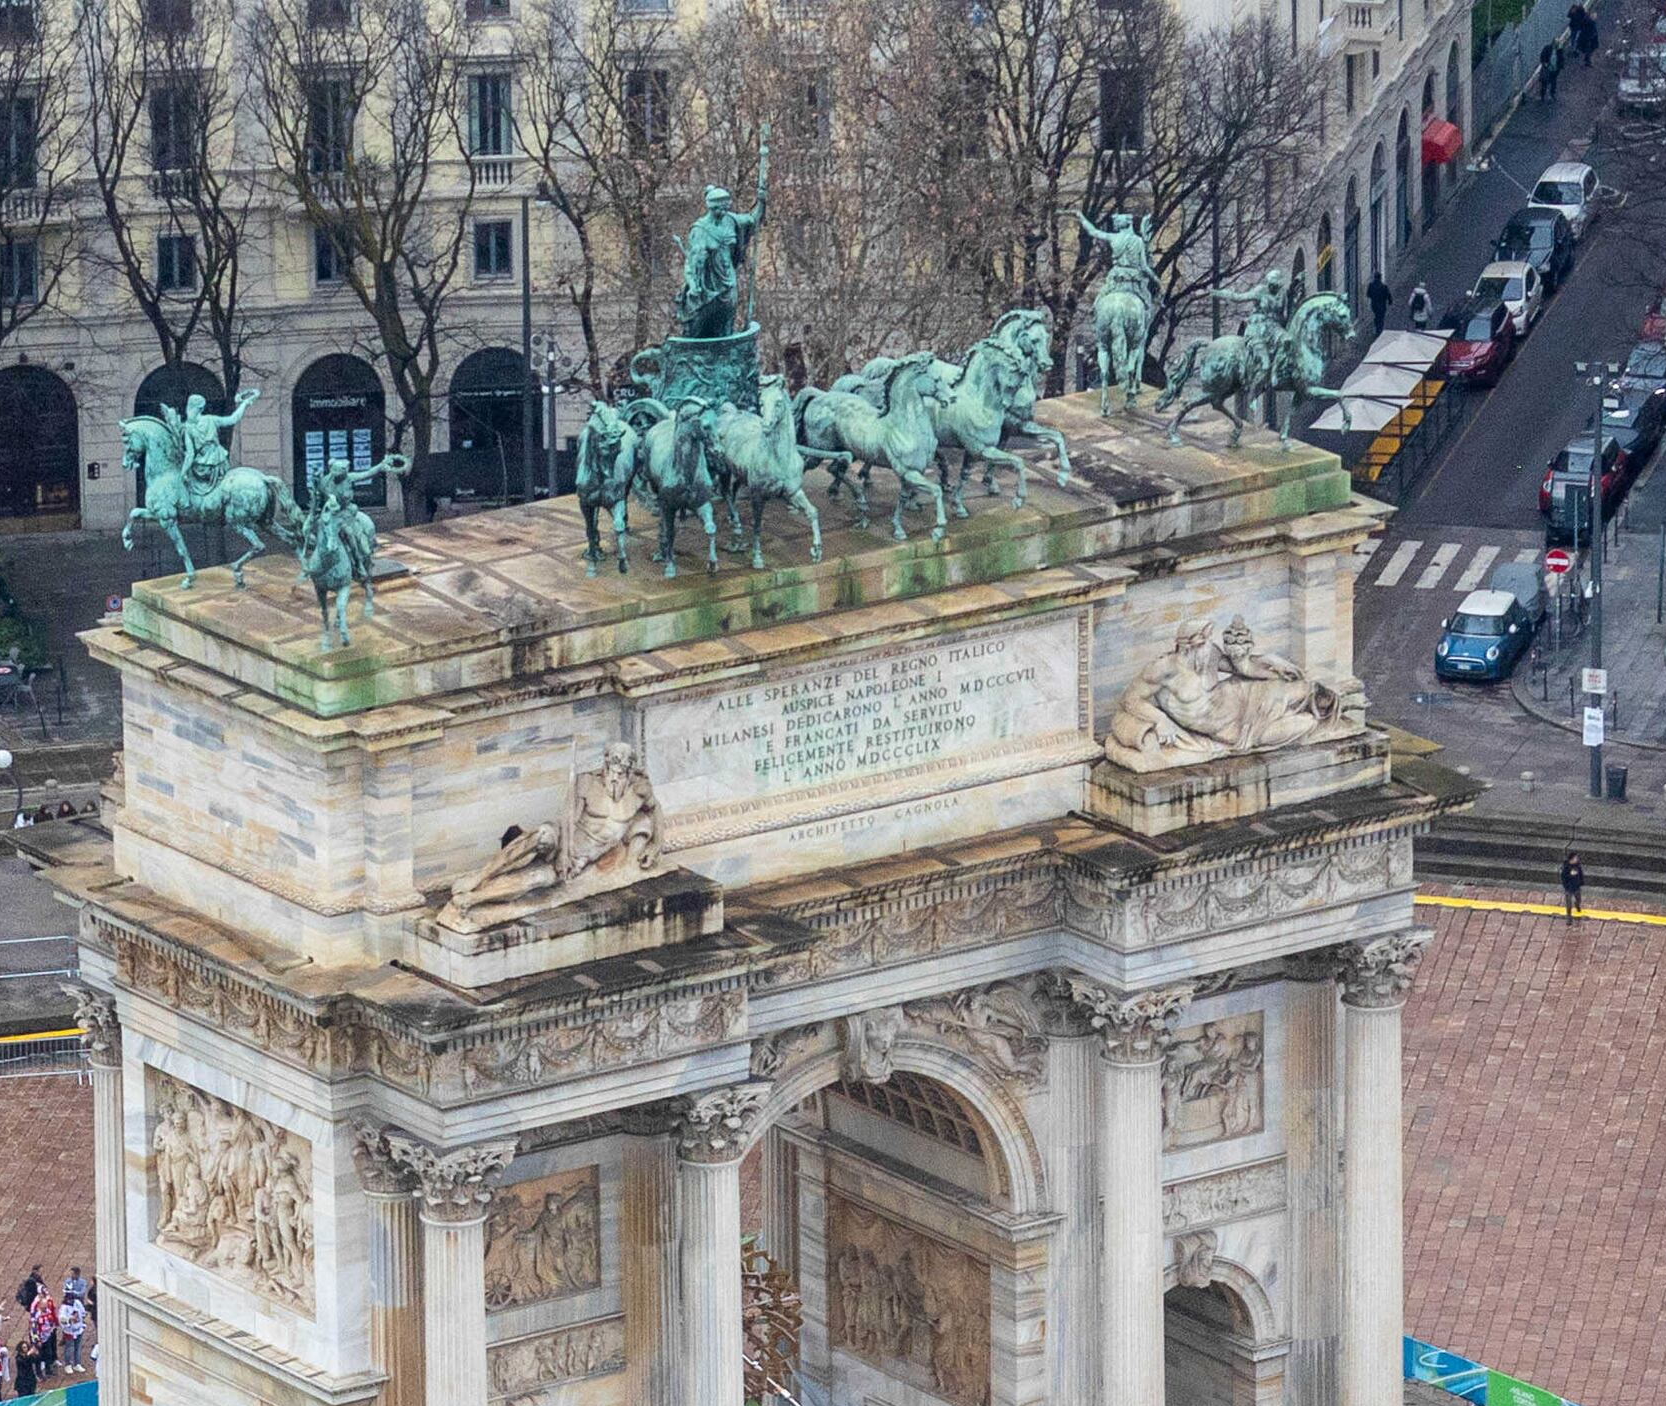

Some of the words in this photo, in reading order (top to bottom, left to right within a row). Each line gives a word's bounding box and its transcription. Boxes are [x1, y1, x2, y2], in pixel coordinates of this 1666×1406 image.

[717, 694, 754, 712] ALLE
[764, 674, 842, 702] SPERANZE
[853, 668, 879, 683] DEL
[891, 653, 938, 675] REGNO
[949, 640, 1005, 663] ITALICO
[781, 693, 834, 715] AUSPICE
[846, 674, 926, 702] NAPOLEONE
[937, 670, 942, 682] I
[702, 722, 774, 748] MILANESI
[786, 700, 882, 732] DEDICARONO
[909, 687, 948, 705] ANNO
[754, 739, 854, 772] FELICEMENTE
[866, 714, 976, 748] RESTITUIRONO
[766, 740, 773, 753] E
[785, 721, 858, 748] FRANCATI
[873, 716, 891, 730] DA
[903, 699, 962, 723] SERVITU
[803, 759, 846, 778] ANNO
[856, 738, 940, 768] MDCCCLIX
[790, 815, 875, 841] ARCHITETTO
[895, 798, 959, 820] CAGNOLA
